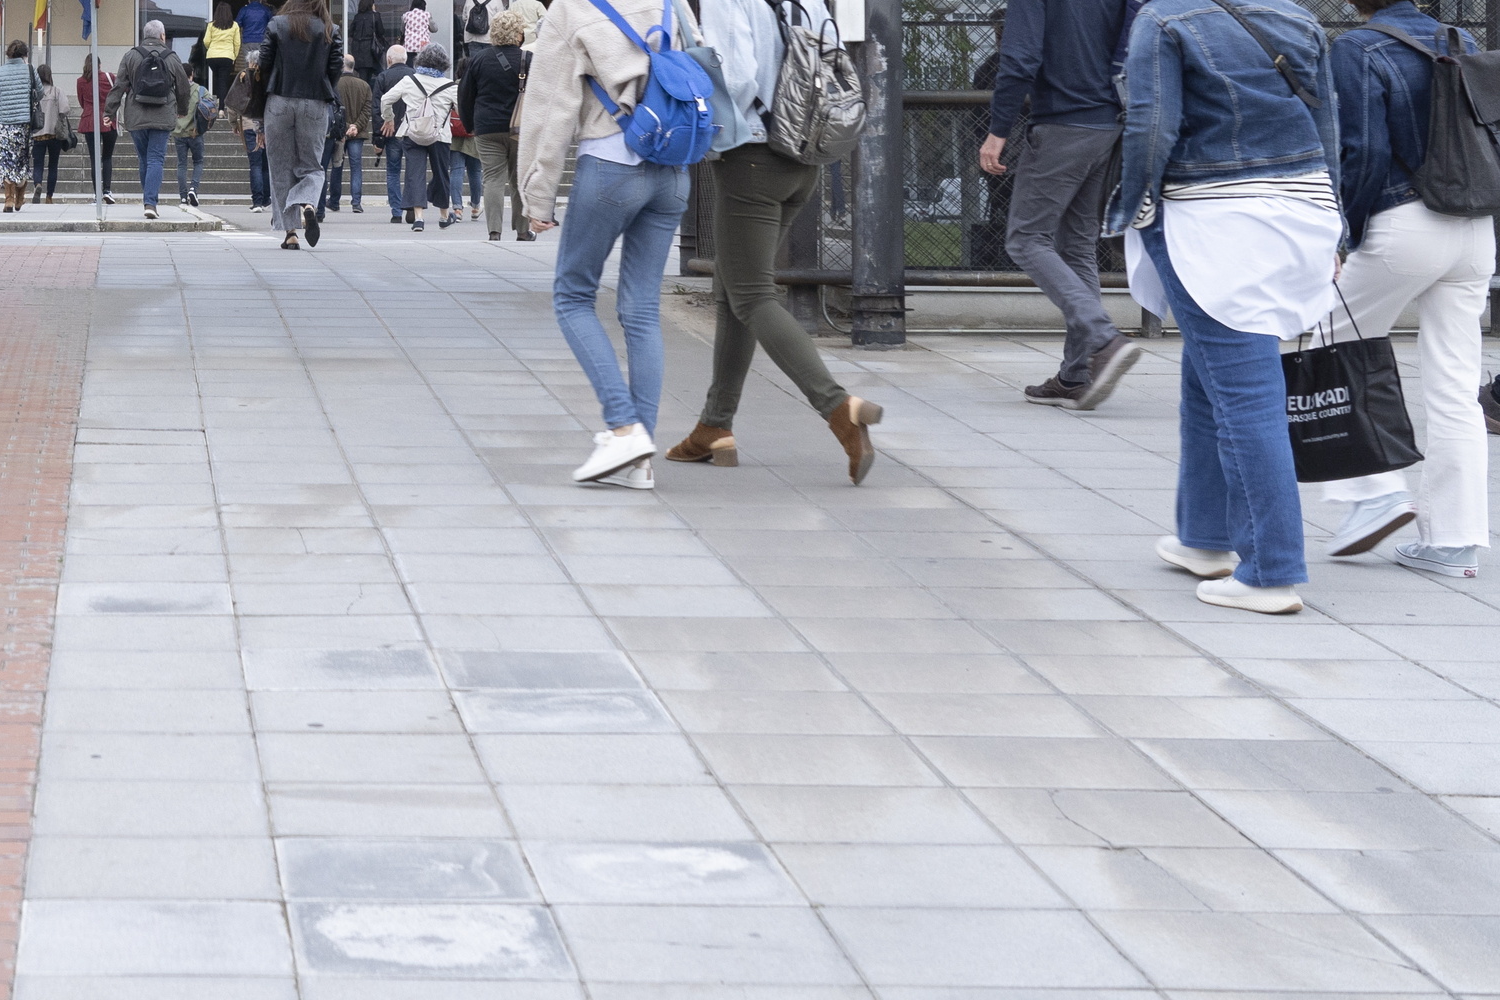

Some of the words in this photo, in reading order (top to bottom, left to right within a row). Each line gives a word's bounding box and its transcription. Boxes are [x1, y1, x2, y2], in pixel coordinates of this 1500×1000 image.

[1287, 386, 1350, 411] EUSKADI
[1287, 411, 1318, 423] BASQUE
[1318, 405, 1352, 419] COUNTRY
